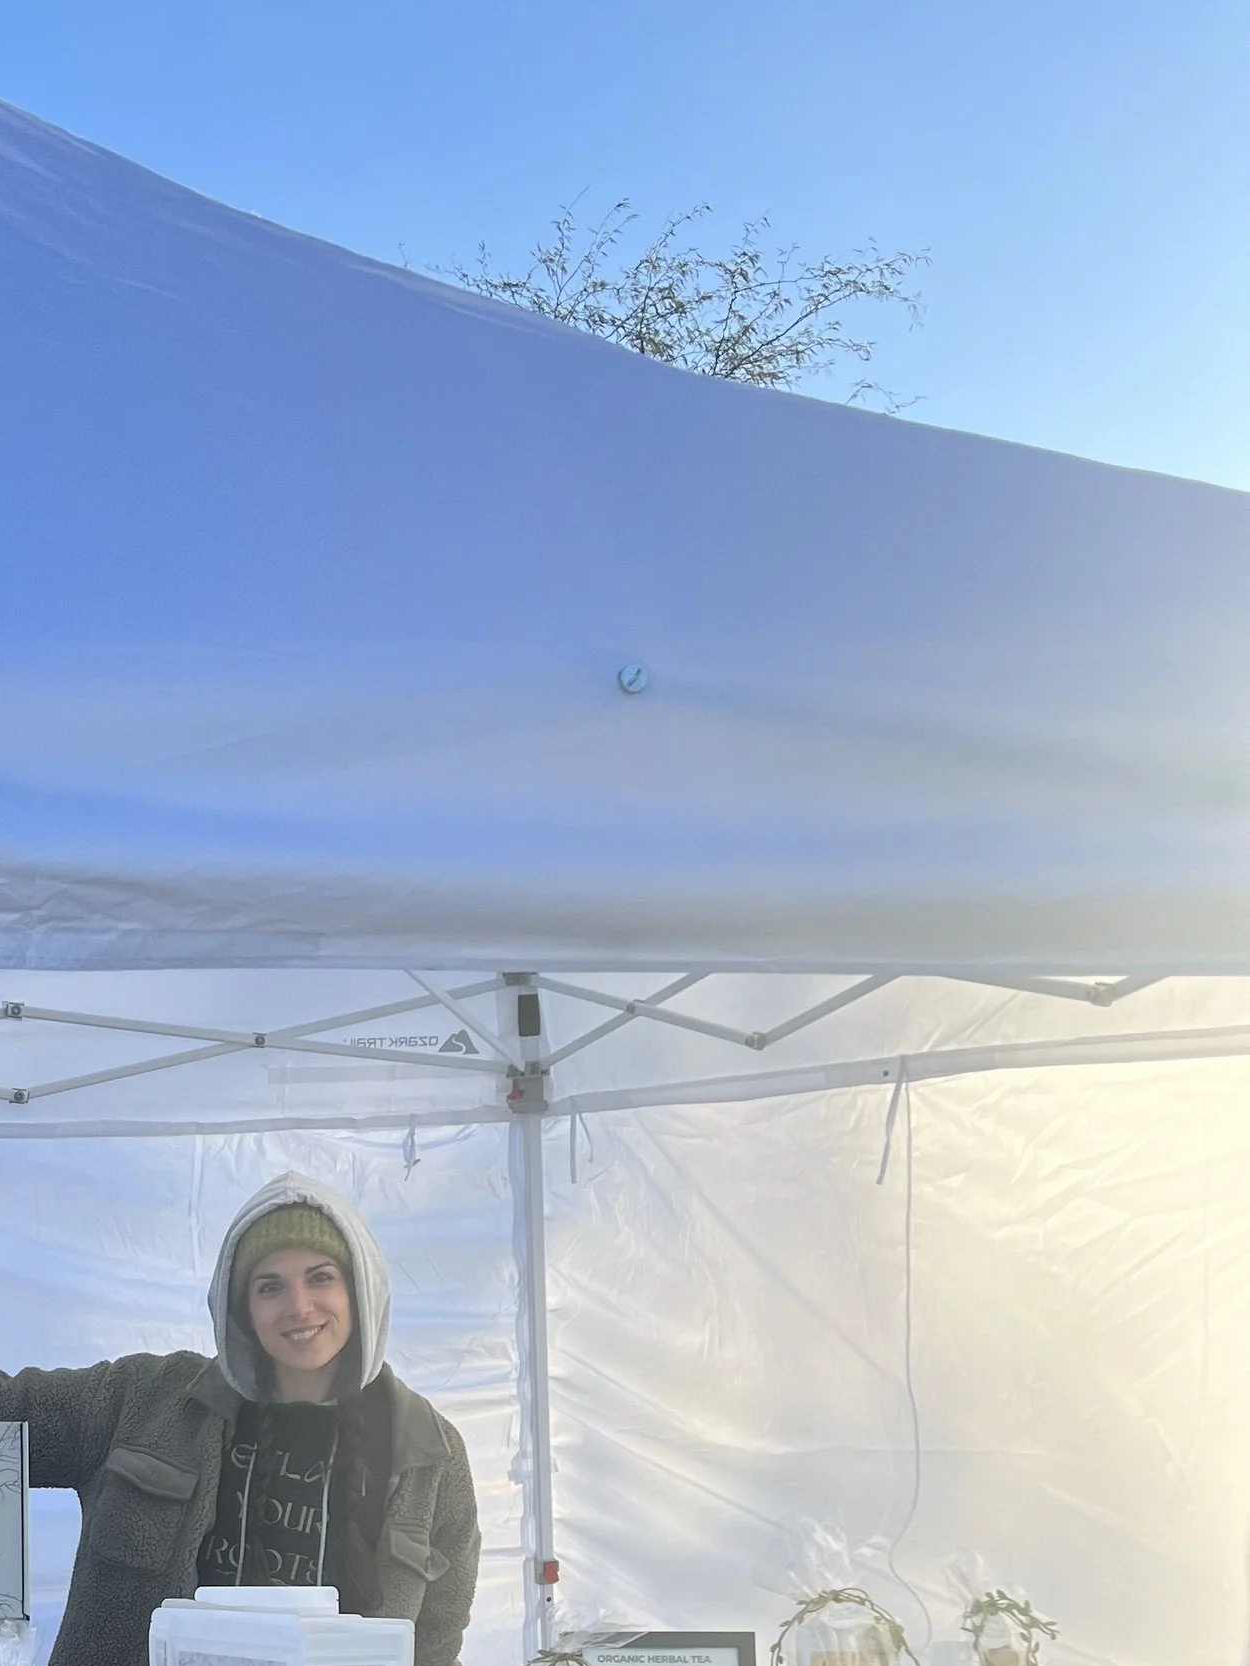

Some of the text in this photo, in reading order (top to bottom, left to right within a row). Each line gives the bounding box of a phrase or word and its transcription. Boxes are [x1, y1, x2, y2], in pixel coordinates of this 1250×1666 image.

[598, 1655, 711, 1664] ORGANIC HERBAL TEA
